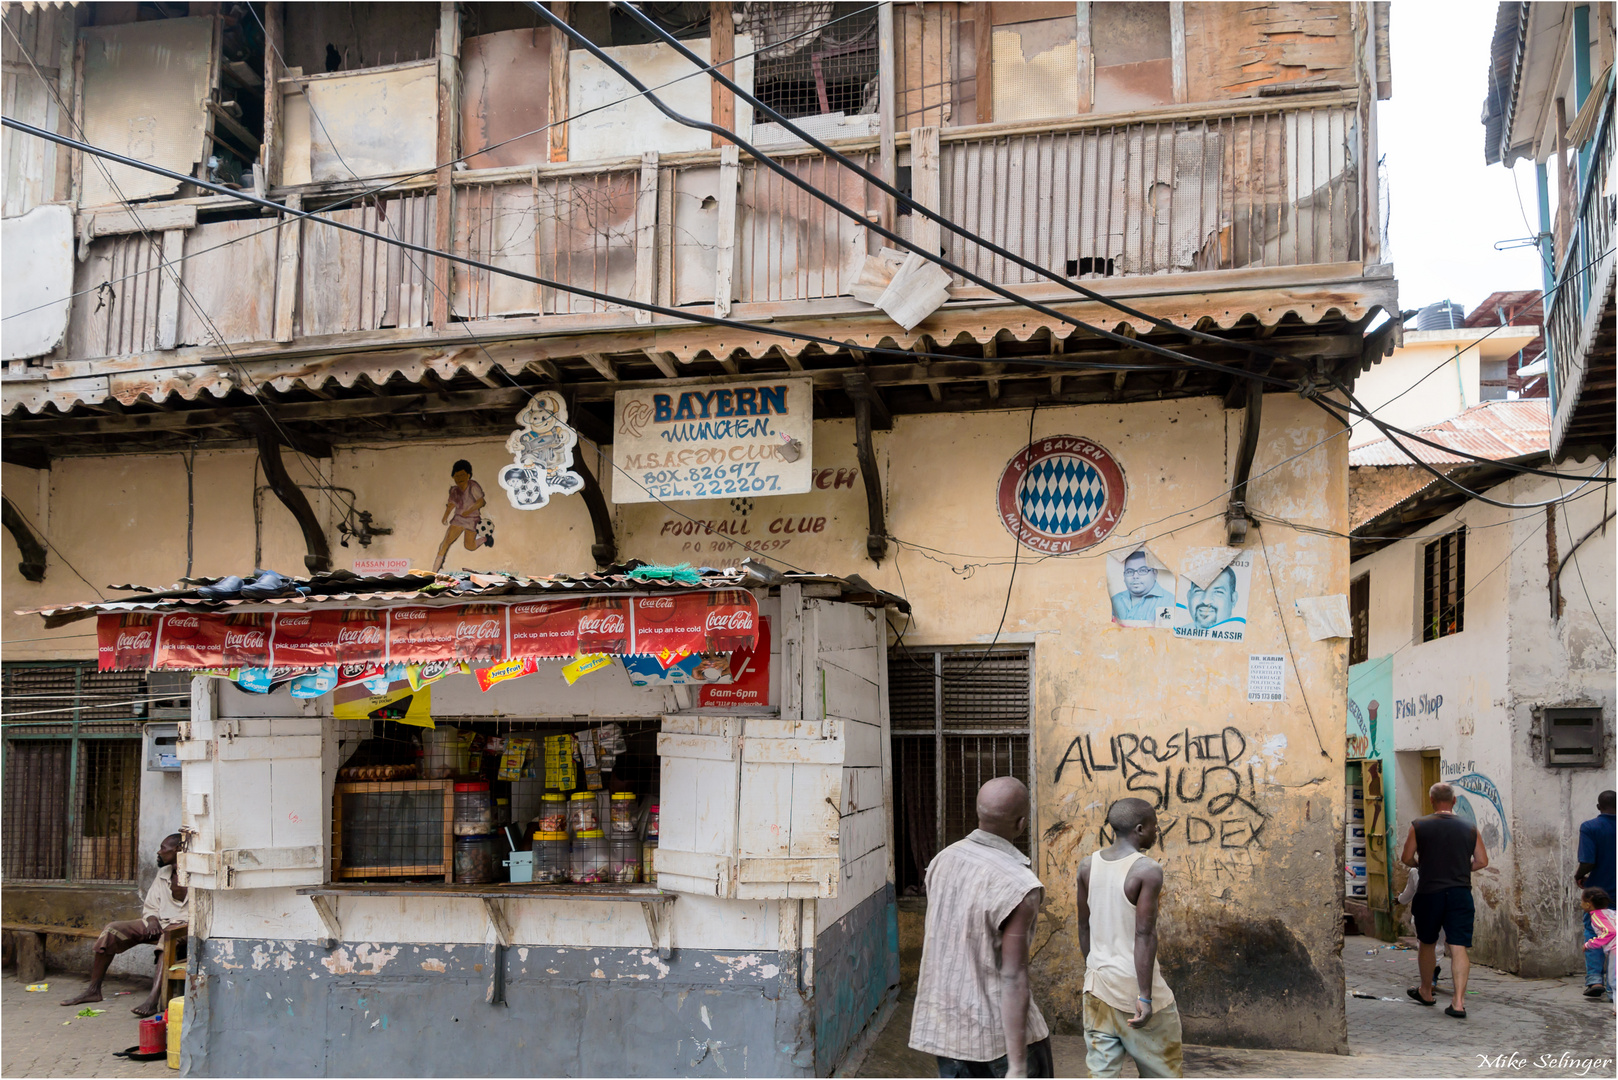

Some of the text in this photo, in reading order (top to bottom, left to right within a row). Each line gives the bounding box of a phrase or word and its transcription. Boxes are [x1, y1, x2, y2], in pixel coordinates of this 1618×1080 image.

[654, 385, 788, 424] BAYERN
[1044, 440, 1104, 460] BAYERN
[769, 517, 826, 534] CLUB
[710, 541, 735, 552] BOX
[743, 539, 791, 552] 82697
[515, 604, 548, 614] Coca-Cola
[640, 598, 674, 608] Coca-Cola
[168, 617, 199, 628] Coca-Cola
[280, 616, 312, 626] Coca-Cola
[395, 610, 428, 620] Coca-Cola
[705, 610, 752, 631] Coca-Cola
[456, 620, 500, 640] Coca-Cola
[578, 614, 625, 634] Coca-Cola
[117, 631, 152, 650] Coca-Cola
[225, 631, 265, 648] Coca-Cola
[338, 626, 380, 645] Coca-Cola
[1176, 627, 1242, 640] SHARIFF NASSIR
[491, 664, 521, 678] Juicy Fruit
[579, 662, 592, 672] Juicy
[710, 689, 757, 699] 6am-6pm
[1396, 694, 1443, 720] Fish Shop
